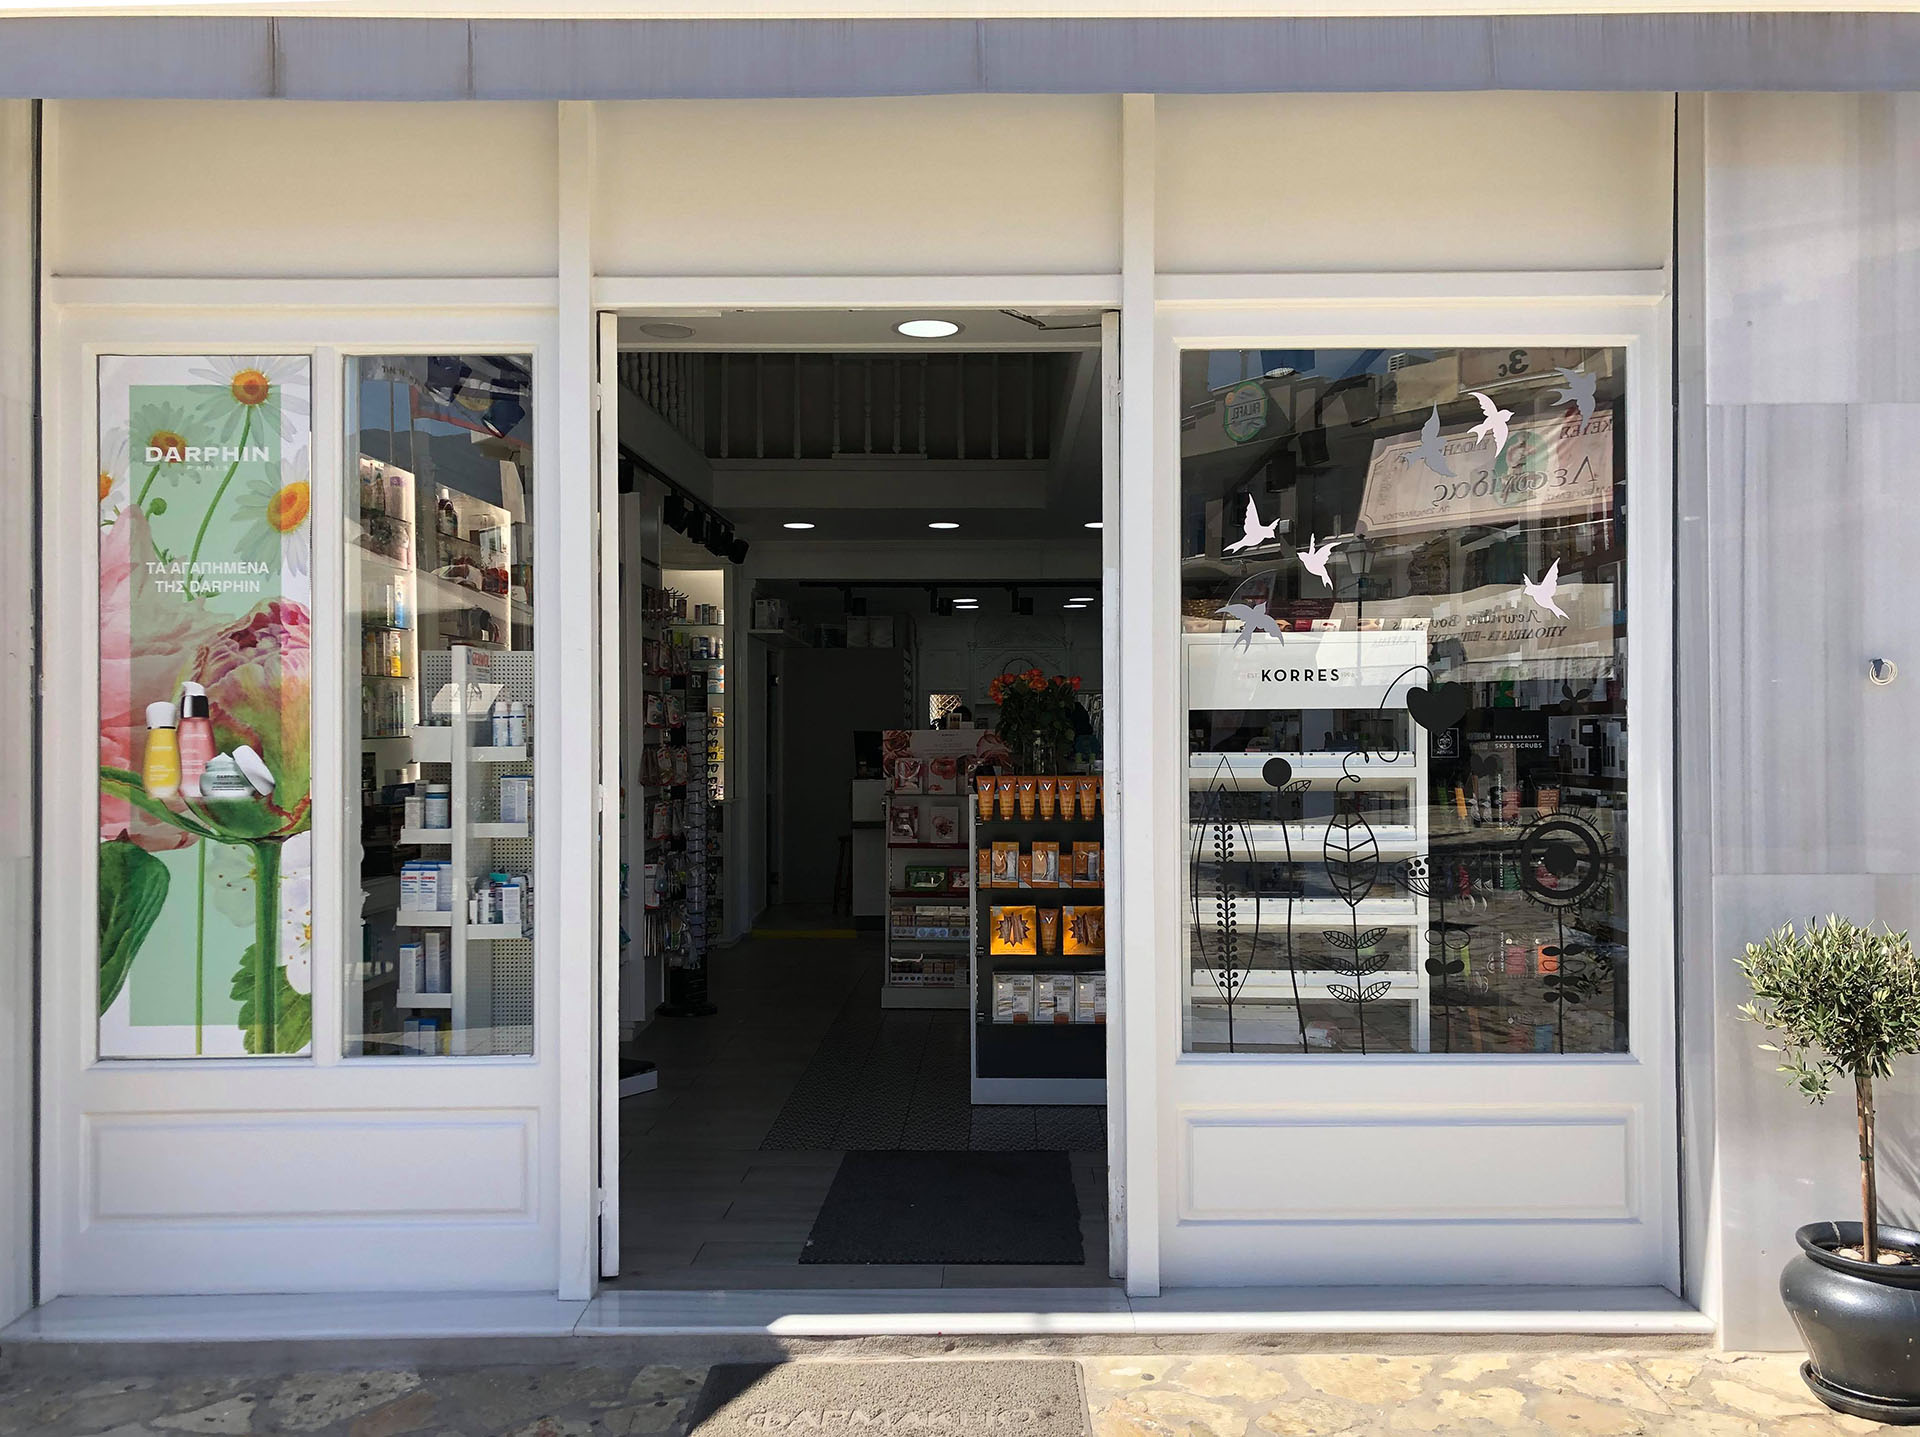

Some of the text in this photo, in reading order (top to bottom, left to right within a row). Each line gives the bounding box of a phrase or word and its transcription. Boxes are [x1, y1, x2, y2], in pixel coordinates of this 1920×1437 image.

[145, 446, 269, 462] DARPHIN
[145, 561, 269, 575] ΤΑ ΑΓΑΠΗΜΕΝΑ
[155, 580, 260, 593] ΤΗΣ DARPHIN
[1261, 668, 1340, 682] KORRES
